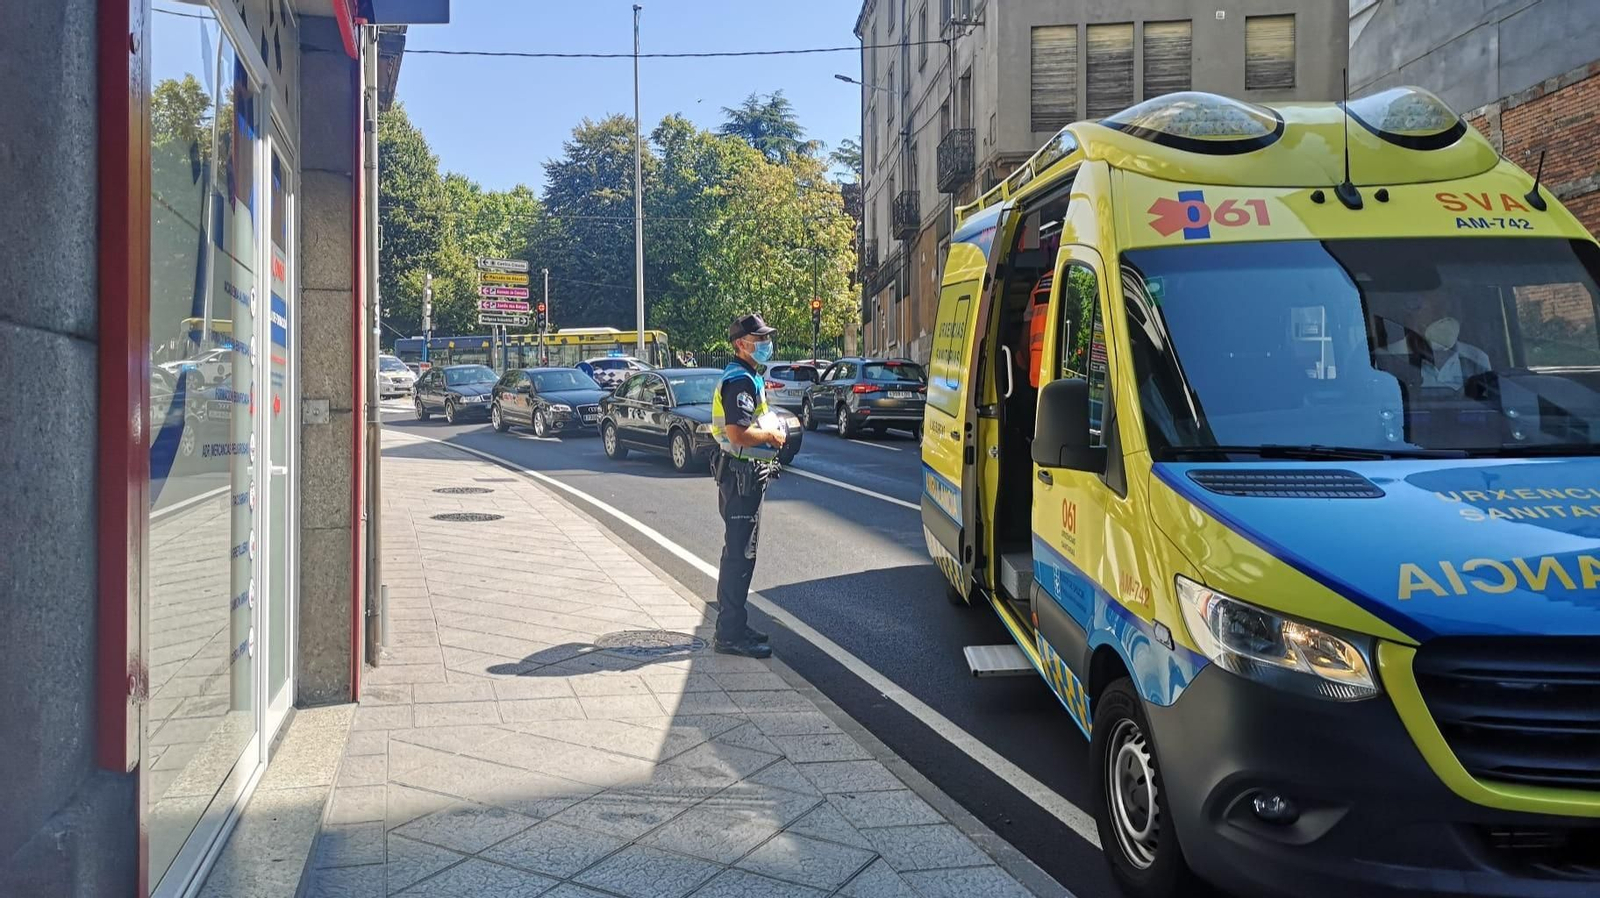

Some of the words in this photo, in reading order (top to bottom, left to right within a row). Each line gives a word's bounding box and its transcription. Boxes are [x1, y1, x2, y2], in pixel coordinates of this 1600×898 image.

[1182, 199, 1271, 228] 061
[1435, 192, 1530, 213] SVA
[1456, 217, 1535, 230] AM-742
[1062, 498, 1077, 534] 061
[1120, 570, 1150, 609] AM-742
